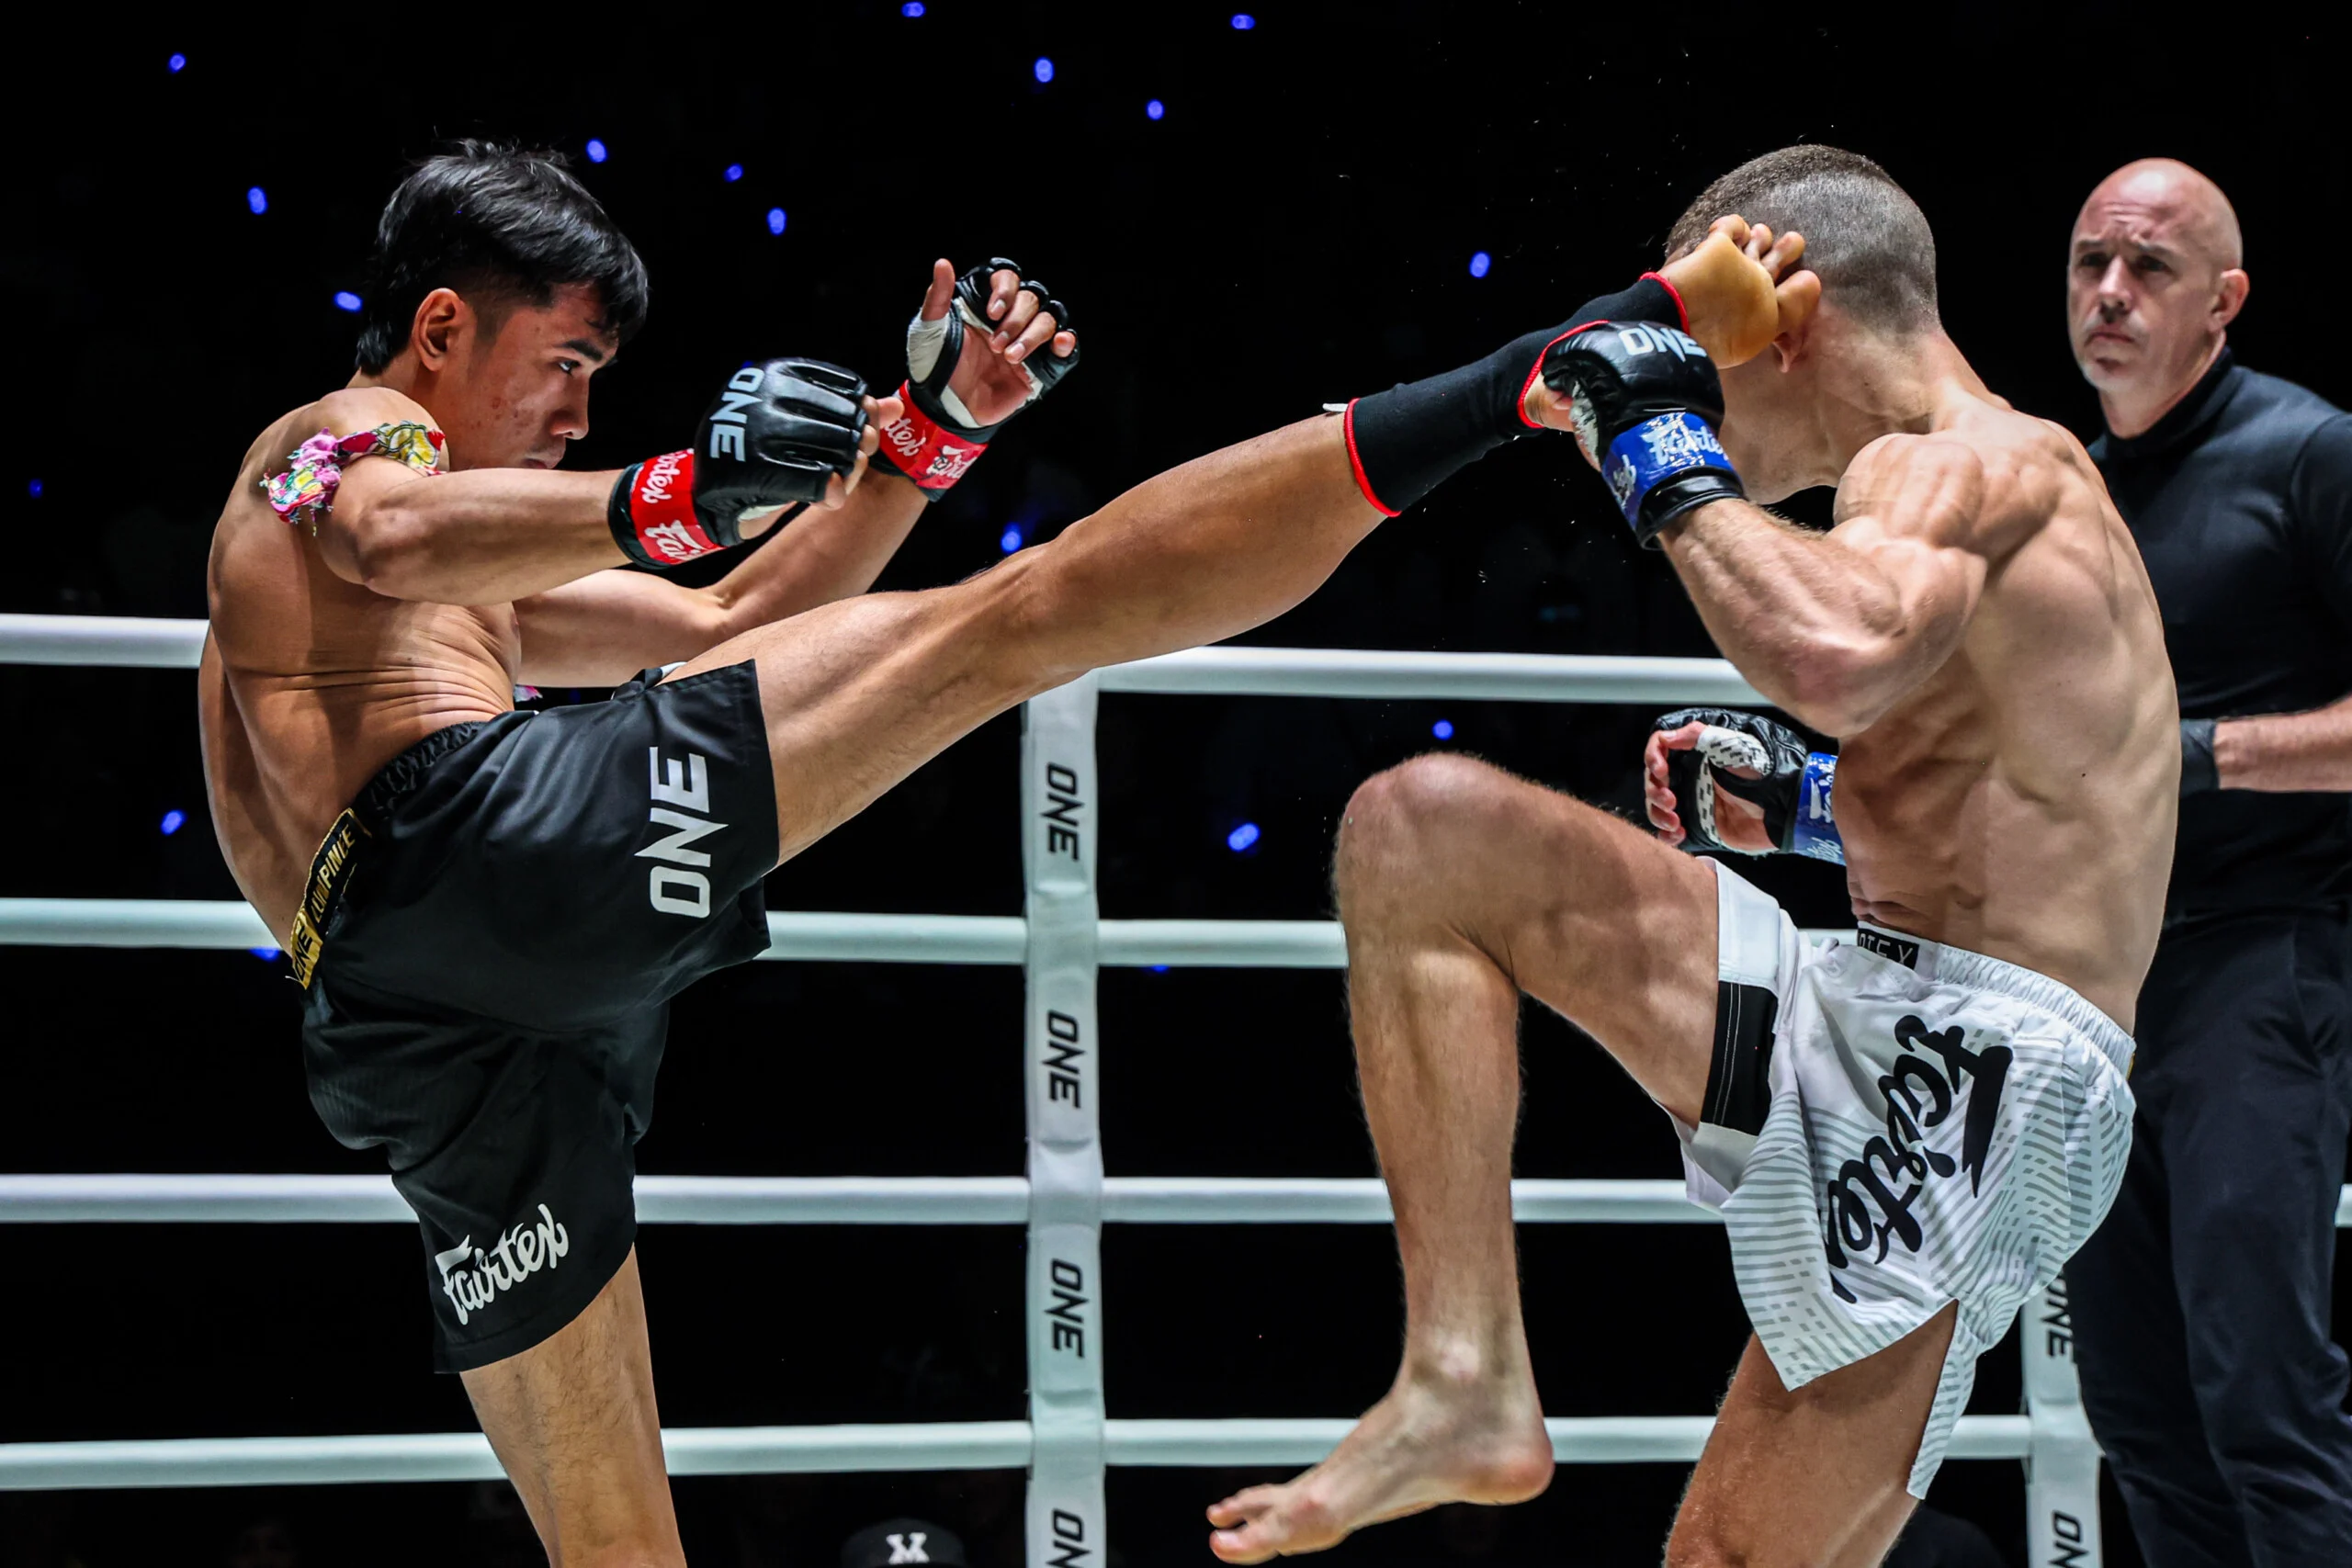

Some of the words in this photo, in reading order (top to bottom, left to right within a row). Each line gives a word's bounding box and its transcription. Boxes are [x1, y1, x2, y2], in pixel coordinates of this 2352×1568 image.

[1618, 322, 1707, 363] ONE
[710, 367, 765, 462] ONE
[635, 746, 729, 918] ONE
[1039, 761, 1086, 862] ONE
[295, 924, 313, 981] ONE
[1042, 1009, 1087, 1109] ONE
[435, 1203, 569, 1325] Fairtex
[1043, 1258, 1090, 1359] ONE
[1046, 1508, 1092, 1568] ON
[2048, 1510, 2089, 1568] ON
